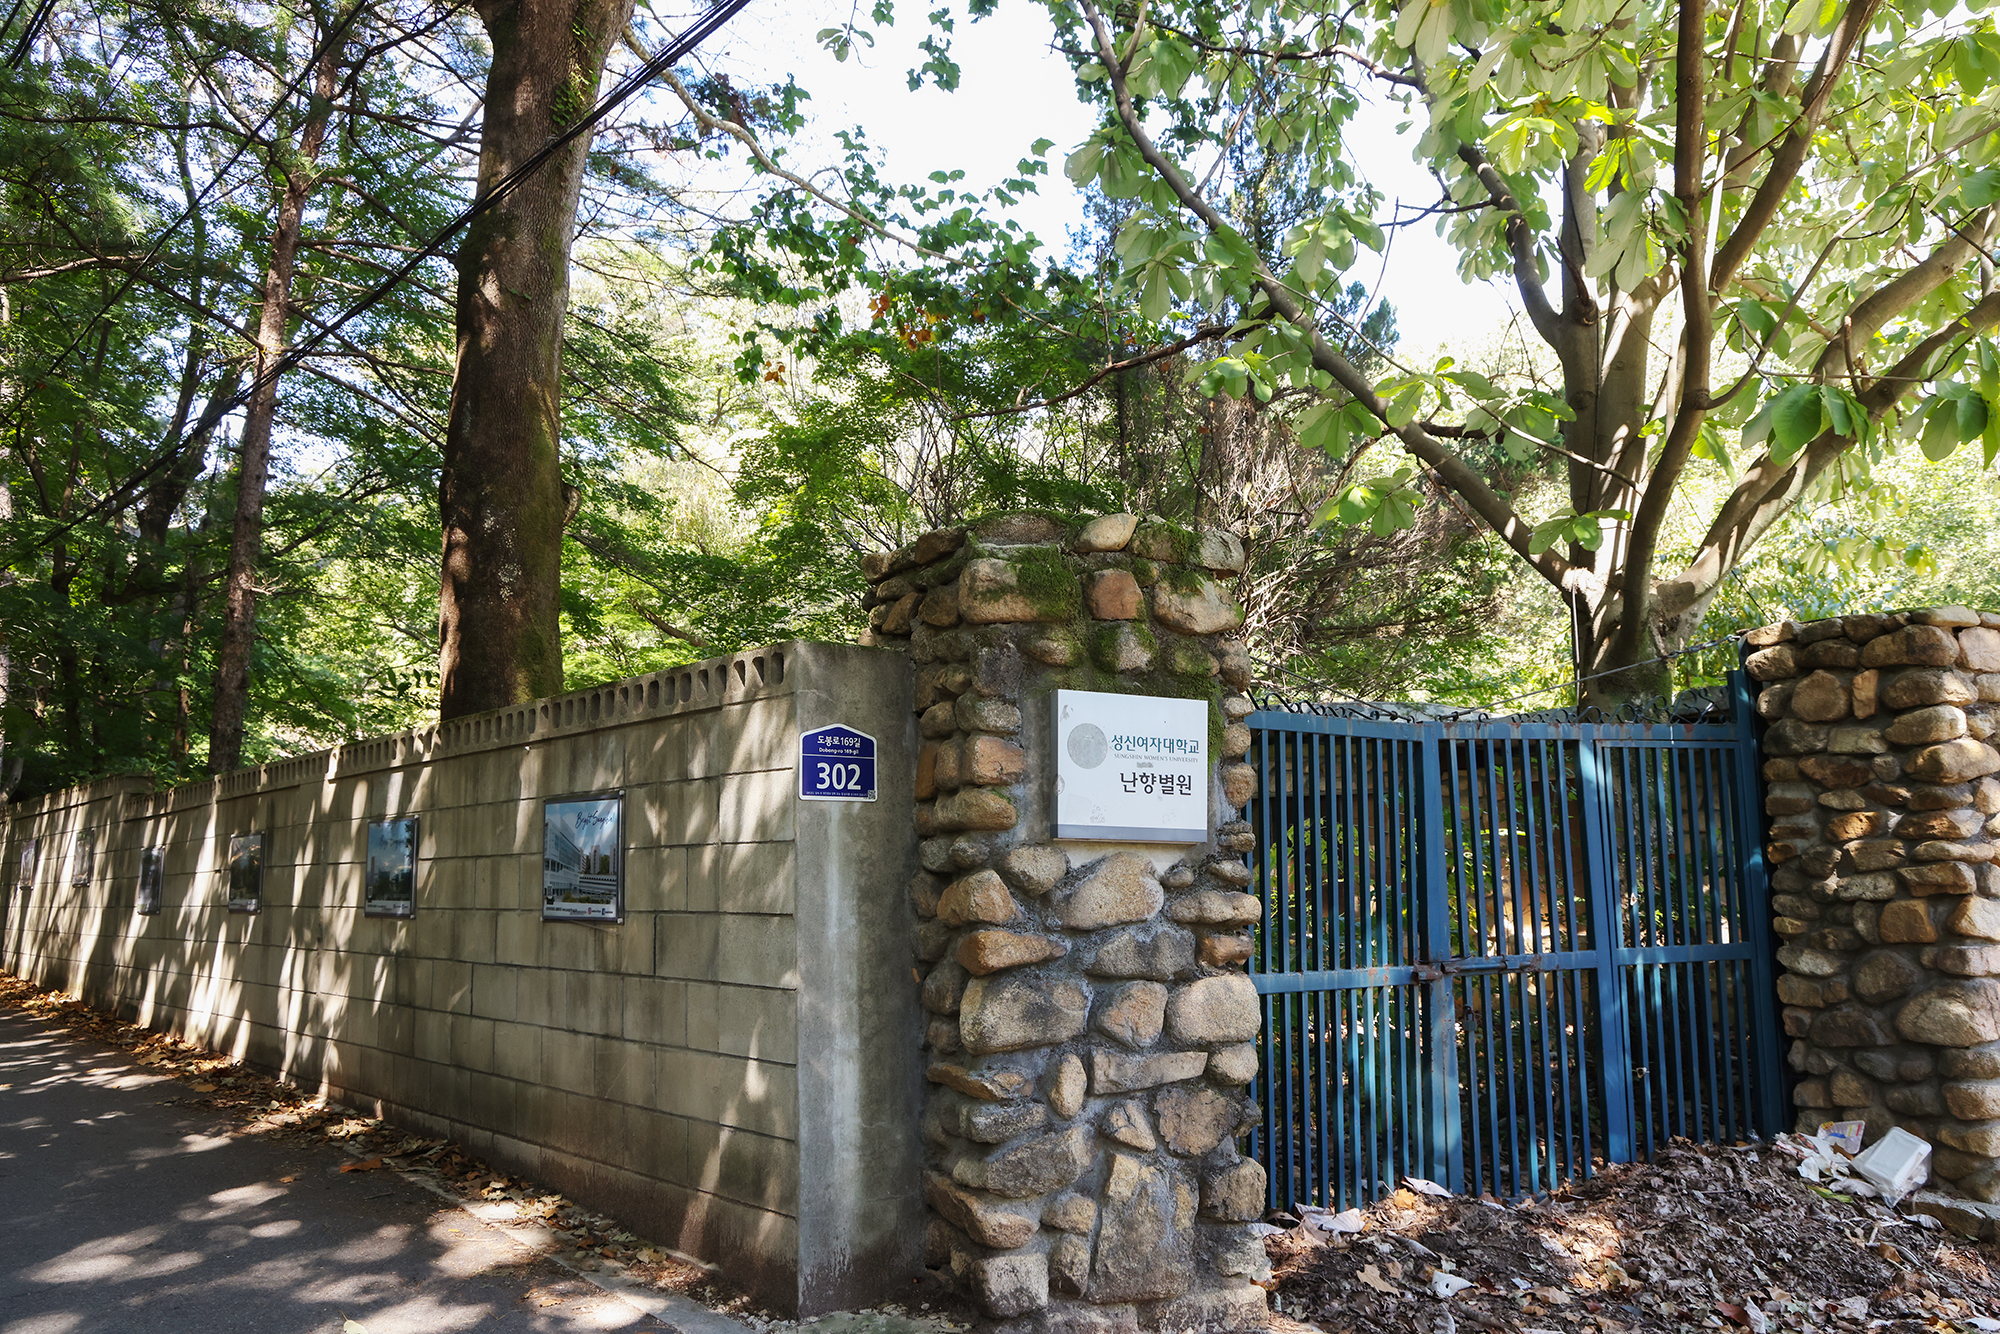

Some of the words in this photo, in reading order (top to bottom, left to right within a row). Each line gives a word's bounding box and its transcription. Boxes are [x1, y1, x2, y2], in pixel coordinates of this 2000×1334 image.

[817, 735, 861, 748] 도봉로169길
[1111, 734, 1200, 754] 성신여자대학교
[816, 762, 862, 790] 302
[1119, 772, 1193, 796] 난향별원
